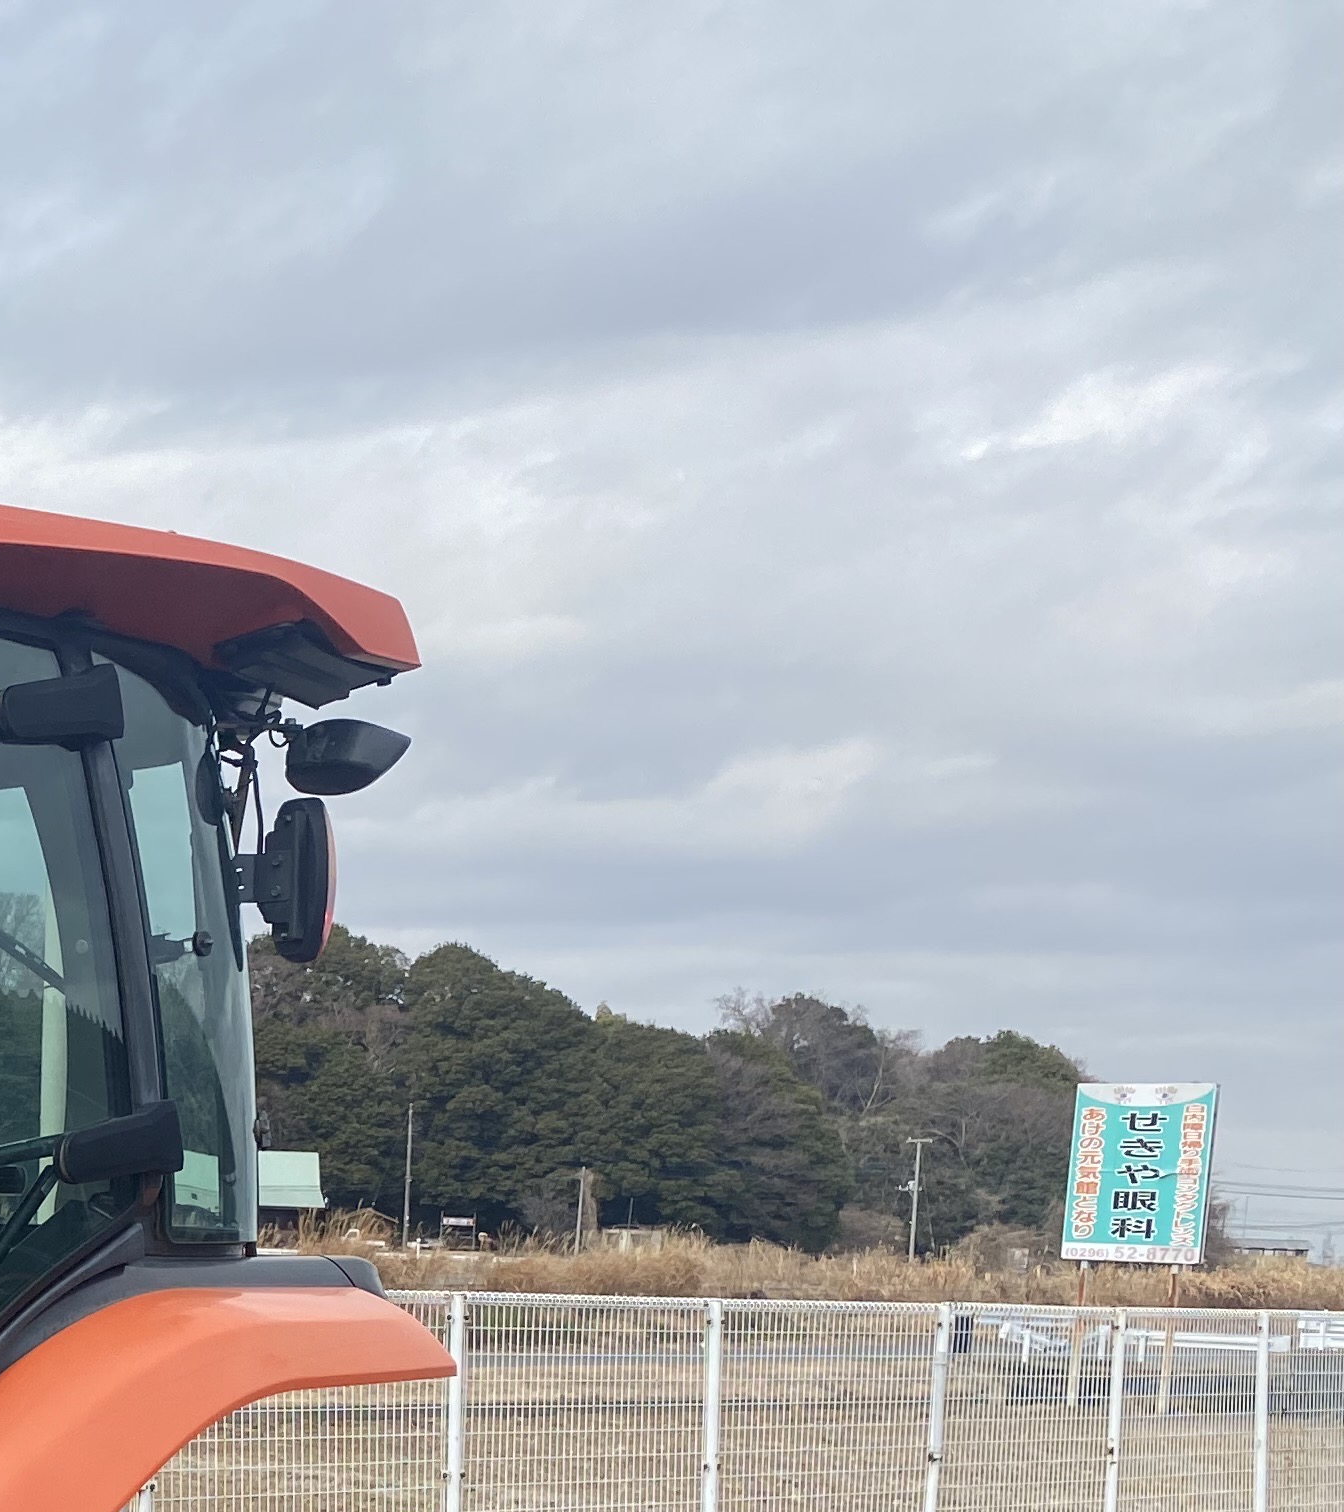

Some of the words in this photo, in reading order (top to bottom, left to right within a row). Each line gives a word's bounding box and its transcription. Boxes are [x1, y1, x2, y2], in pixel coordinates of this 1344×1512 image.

[1111, 1112, 1167, 1239] せきや眼科
[1065, 1247, 1110, 1258] (0296)
[1114, 1246, 1196, 1261] 52-8770
